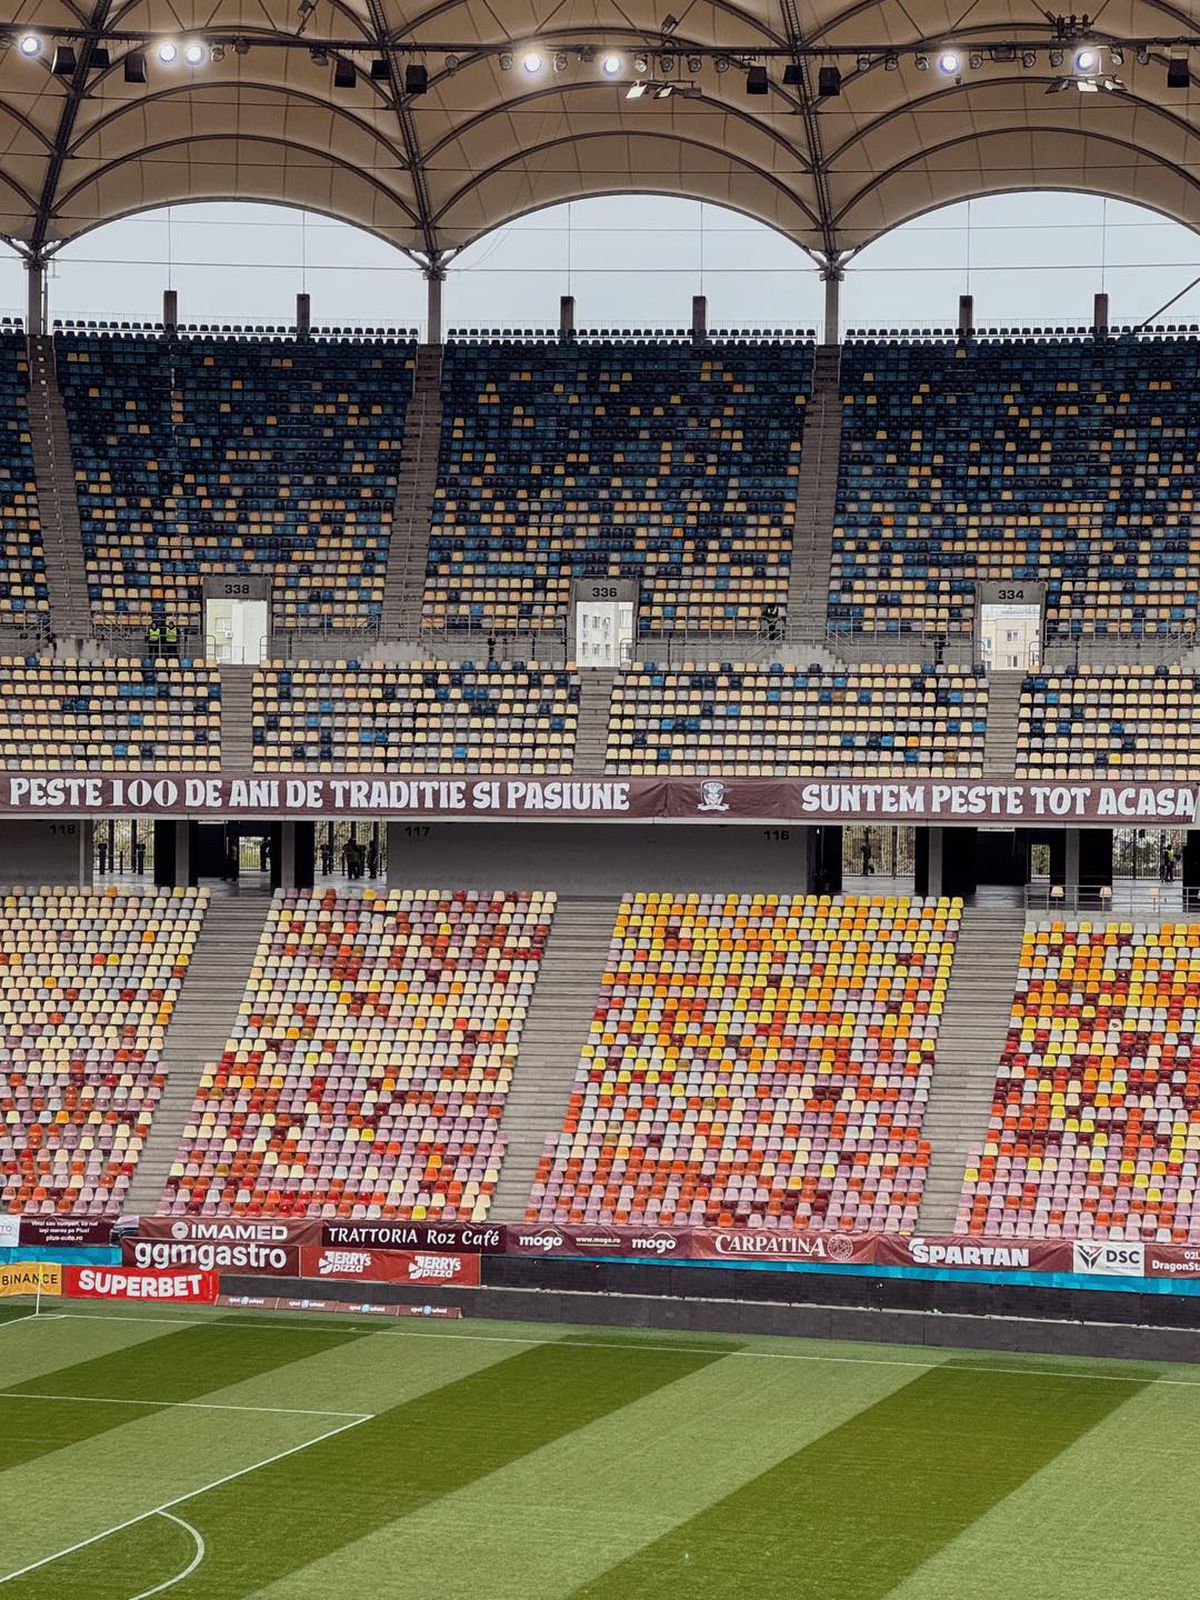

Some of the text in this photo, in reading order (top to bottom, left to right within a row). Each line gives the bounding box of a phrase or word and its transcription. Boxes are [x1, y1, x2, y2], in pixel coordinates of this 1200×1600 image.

[225, 585, 249, 594] 338
[592, 588, 617, 597] 336
[999, 590, 1024, 599] 334
[10, 778, 630, 811] PESTE 100 DE ANI DE TRADITIE SI PASIUNE
[801, 784, 1195, 816] SUNTEM PESTE TOT ACASA
[49, 824, 76, 835] 118
[404, 826, 430, 837] 117
[764, 830, 790, 841] 116
[191, 1224, 288, 1240] IMAMED
[328, 1227, 499, 1247] TRATTORIA Roz Café
[519, 1235, 563, 1251] mogo
[632, 1238, 676, 1253] mogo
[714, 1234, 827, 1257] CARPATINA
[135, 1242, 287, 1271] ggmgastro
[908, 1238, 1030, 1267] SPARTAN
[1106, 1250, 1140, 1264] DSC
[332, 1264, 364, 1273] pizza
[422, 1269, 454, 1278] pizza
[2, 1273, 58, 1285] BINANCE
[78, 1270, 203, 1297] SUPERBET
